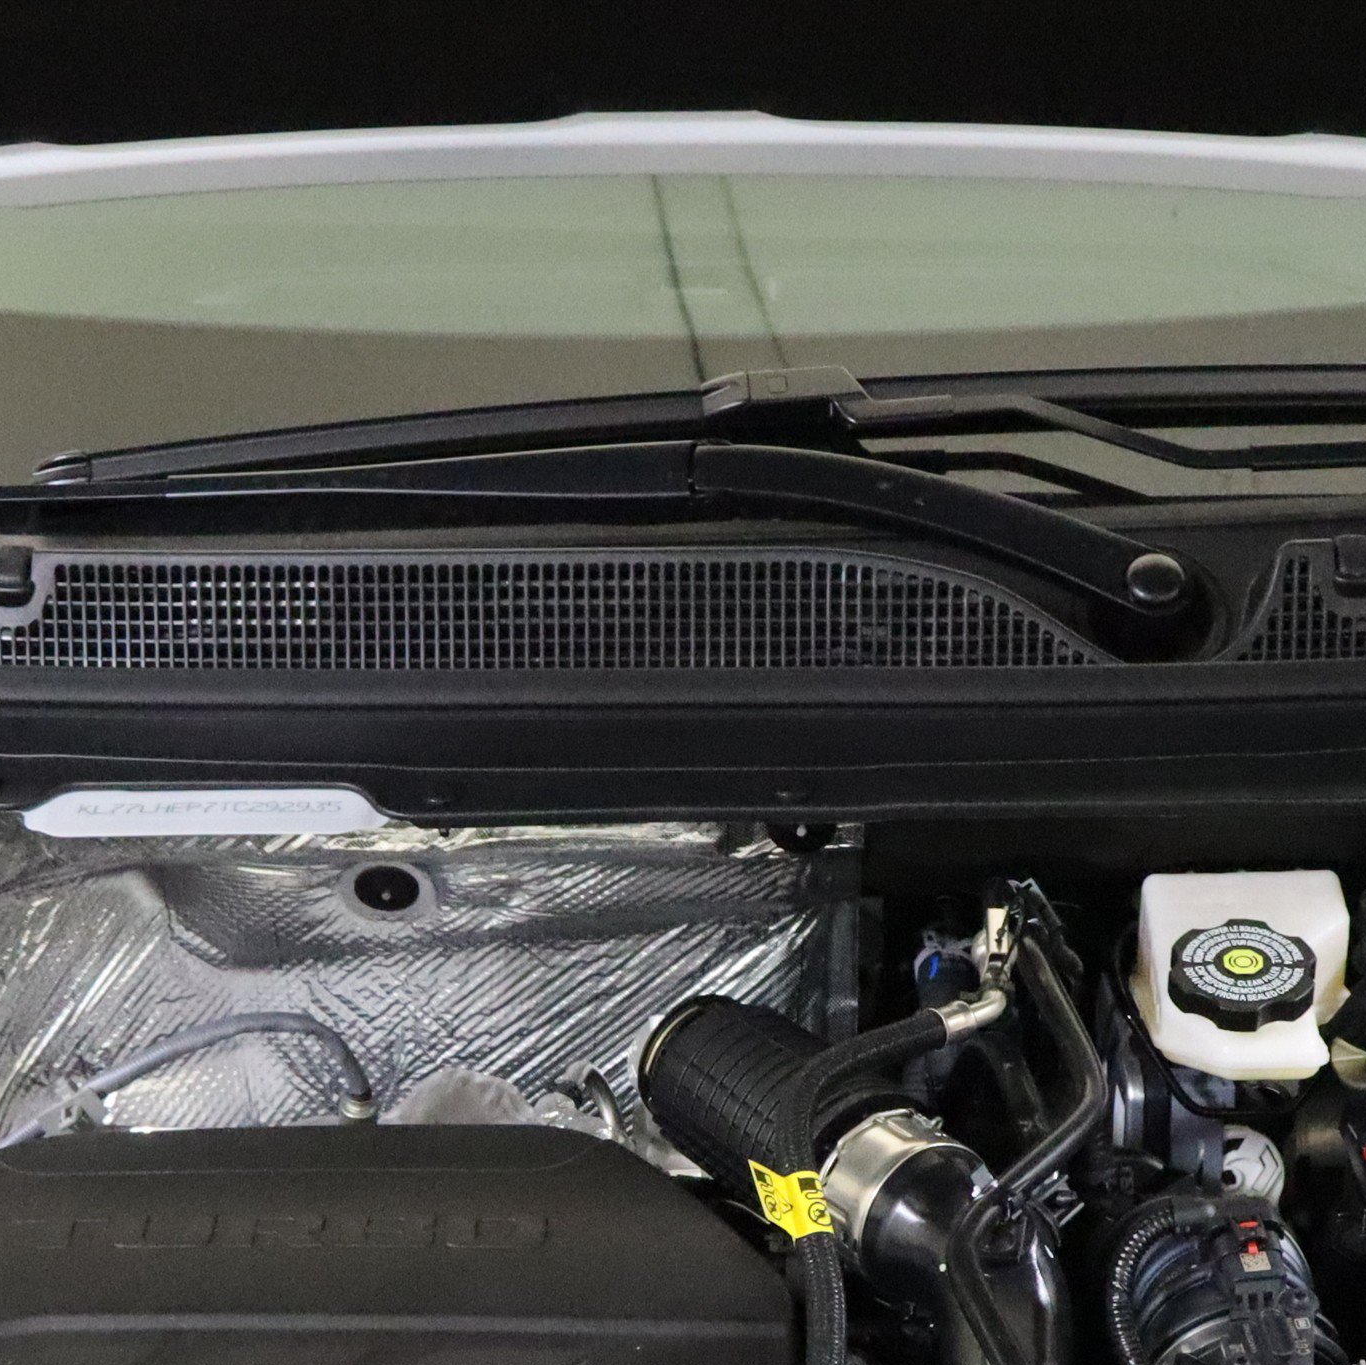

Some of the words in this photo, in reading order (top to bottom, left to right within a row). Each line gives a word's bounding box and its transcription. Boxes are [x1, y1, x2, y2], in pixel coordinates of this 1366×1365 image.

[1237, 978, 1265, 987] CLEAN
[1214, 989, 1240, 1001] FROM
[1239, 994, 1247, 1002] A
